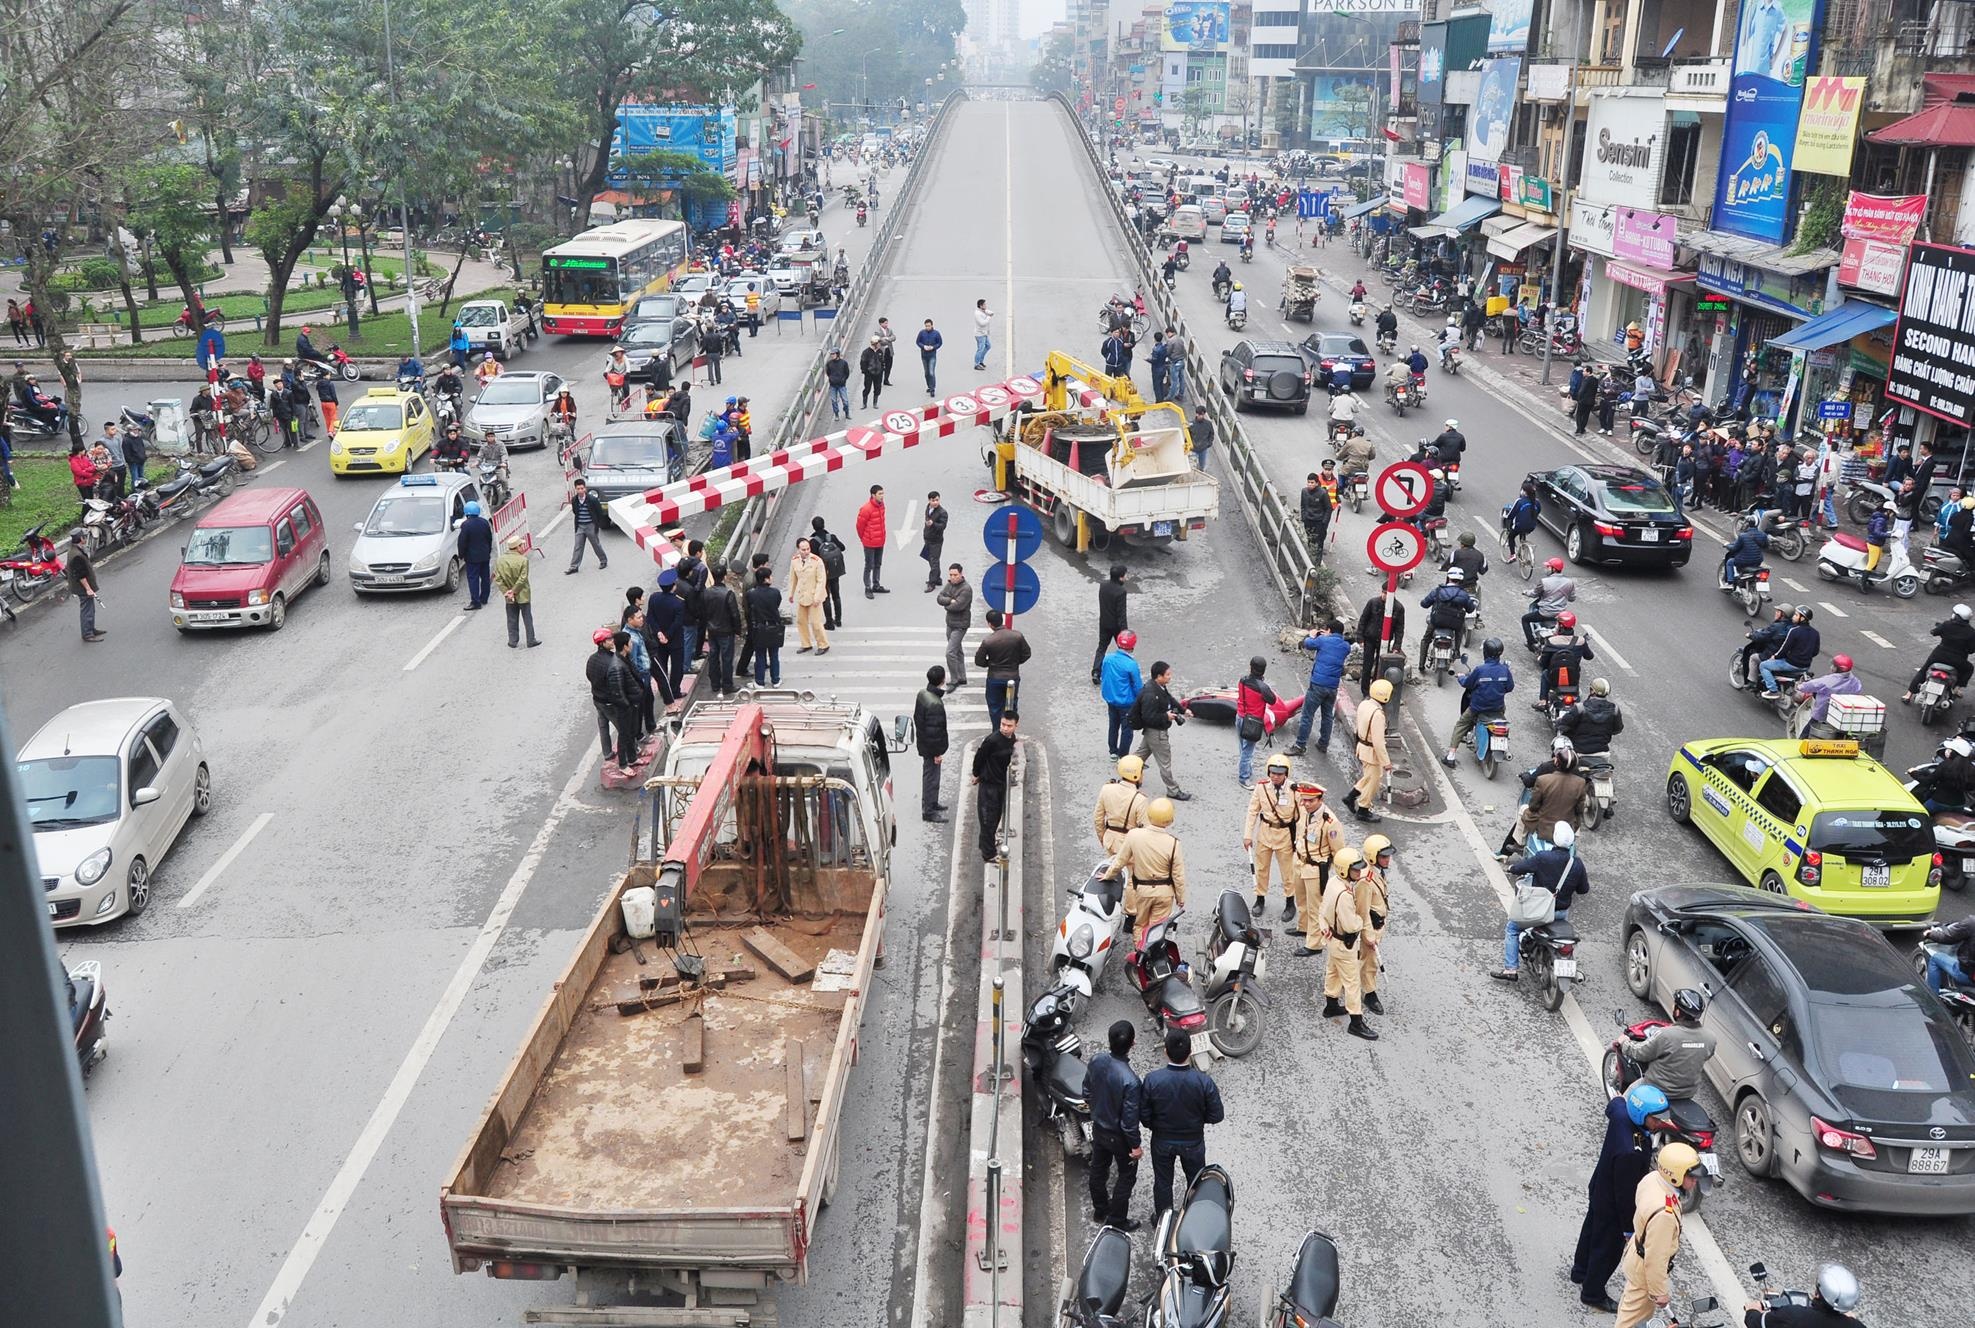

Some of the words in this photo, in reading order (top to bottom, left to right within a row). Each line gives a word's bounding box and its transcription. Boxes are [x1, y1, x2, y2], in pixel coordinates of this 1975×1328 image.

[1314, 0, 1396, 10] PARKSON
[1597, 127, 1652, 170] Sensini
[1609, 170, 1634, 184] Collection
[1904, 251, 1936, 322] KÍNH
[1905, 328, 1951, 359] SECOND
[890, 414, 913, 430] 25
[1869, 866, 1883, 876] 29A
[1920, 1147, 1941, 1160] 29A
